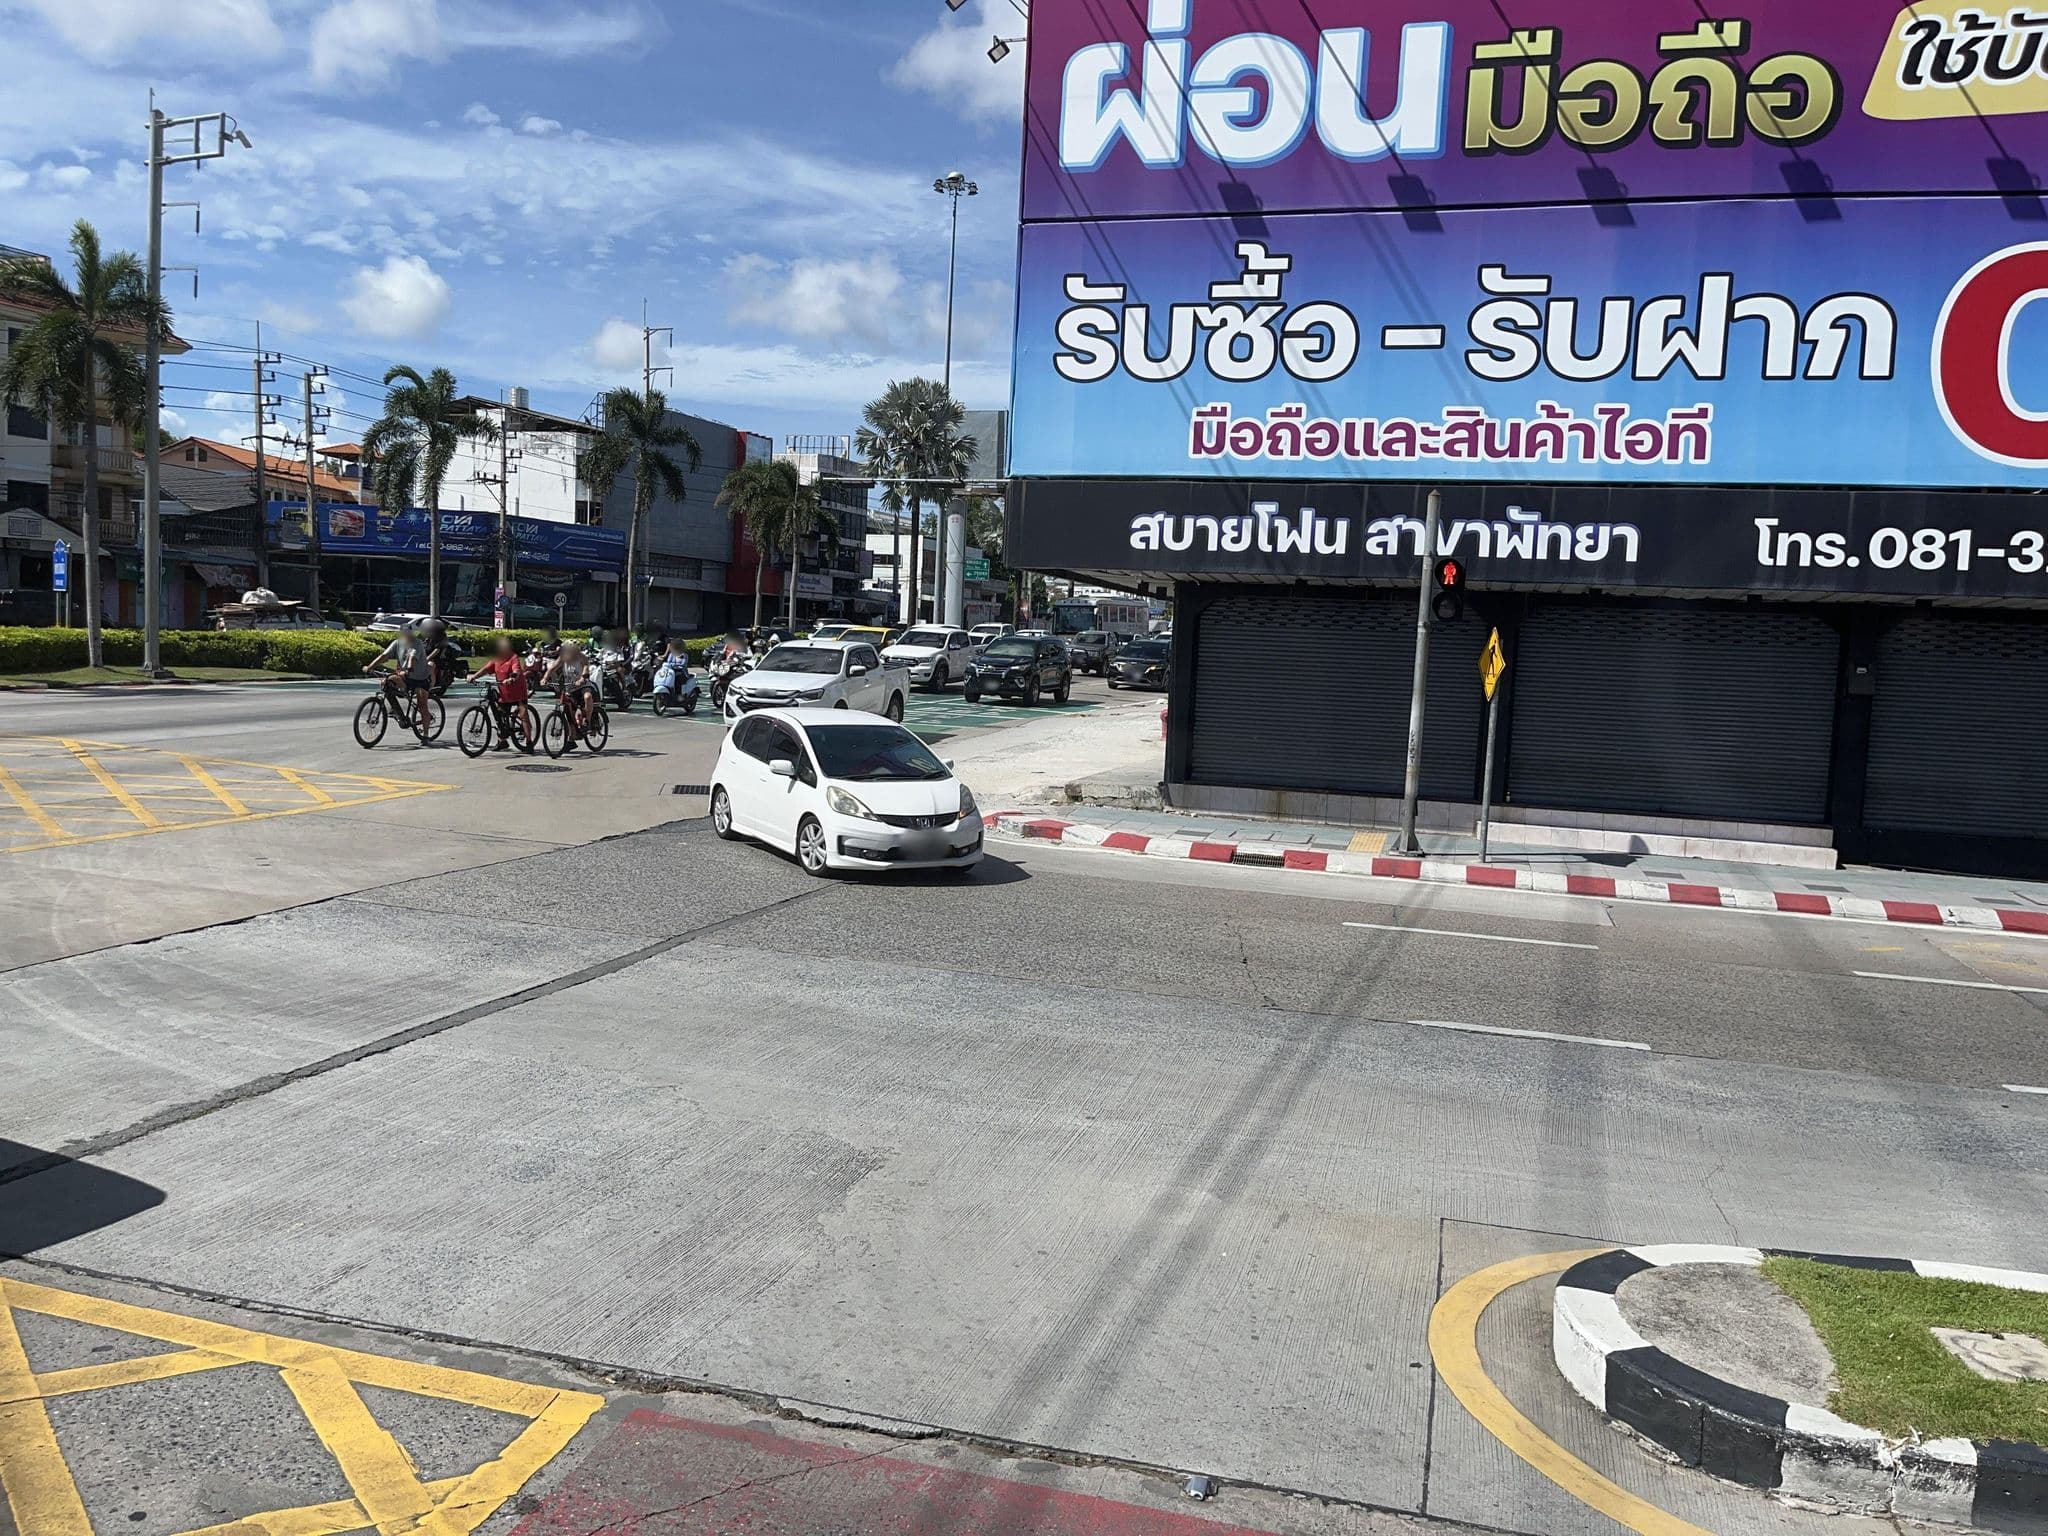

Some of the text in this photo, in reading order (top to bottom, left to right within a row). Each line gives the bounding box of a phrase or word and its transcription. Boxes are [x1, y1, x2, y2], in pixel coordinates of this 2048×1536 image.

[1059, 0, 1843, 172] ผ่อน มือถือ
[1898, 11, 2048, 87] ใช้บั
[1053, 240, 1360, 383] รับซื้อ
[1465, 263, 1898, 381] รับฝาก
[1190, 402, 1713, 464] มือถือและสินค้าไอที
[1129, 501, 1350, 555] สบายโฟน
